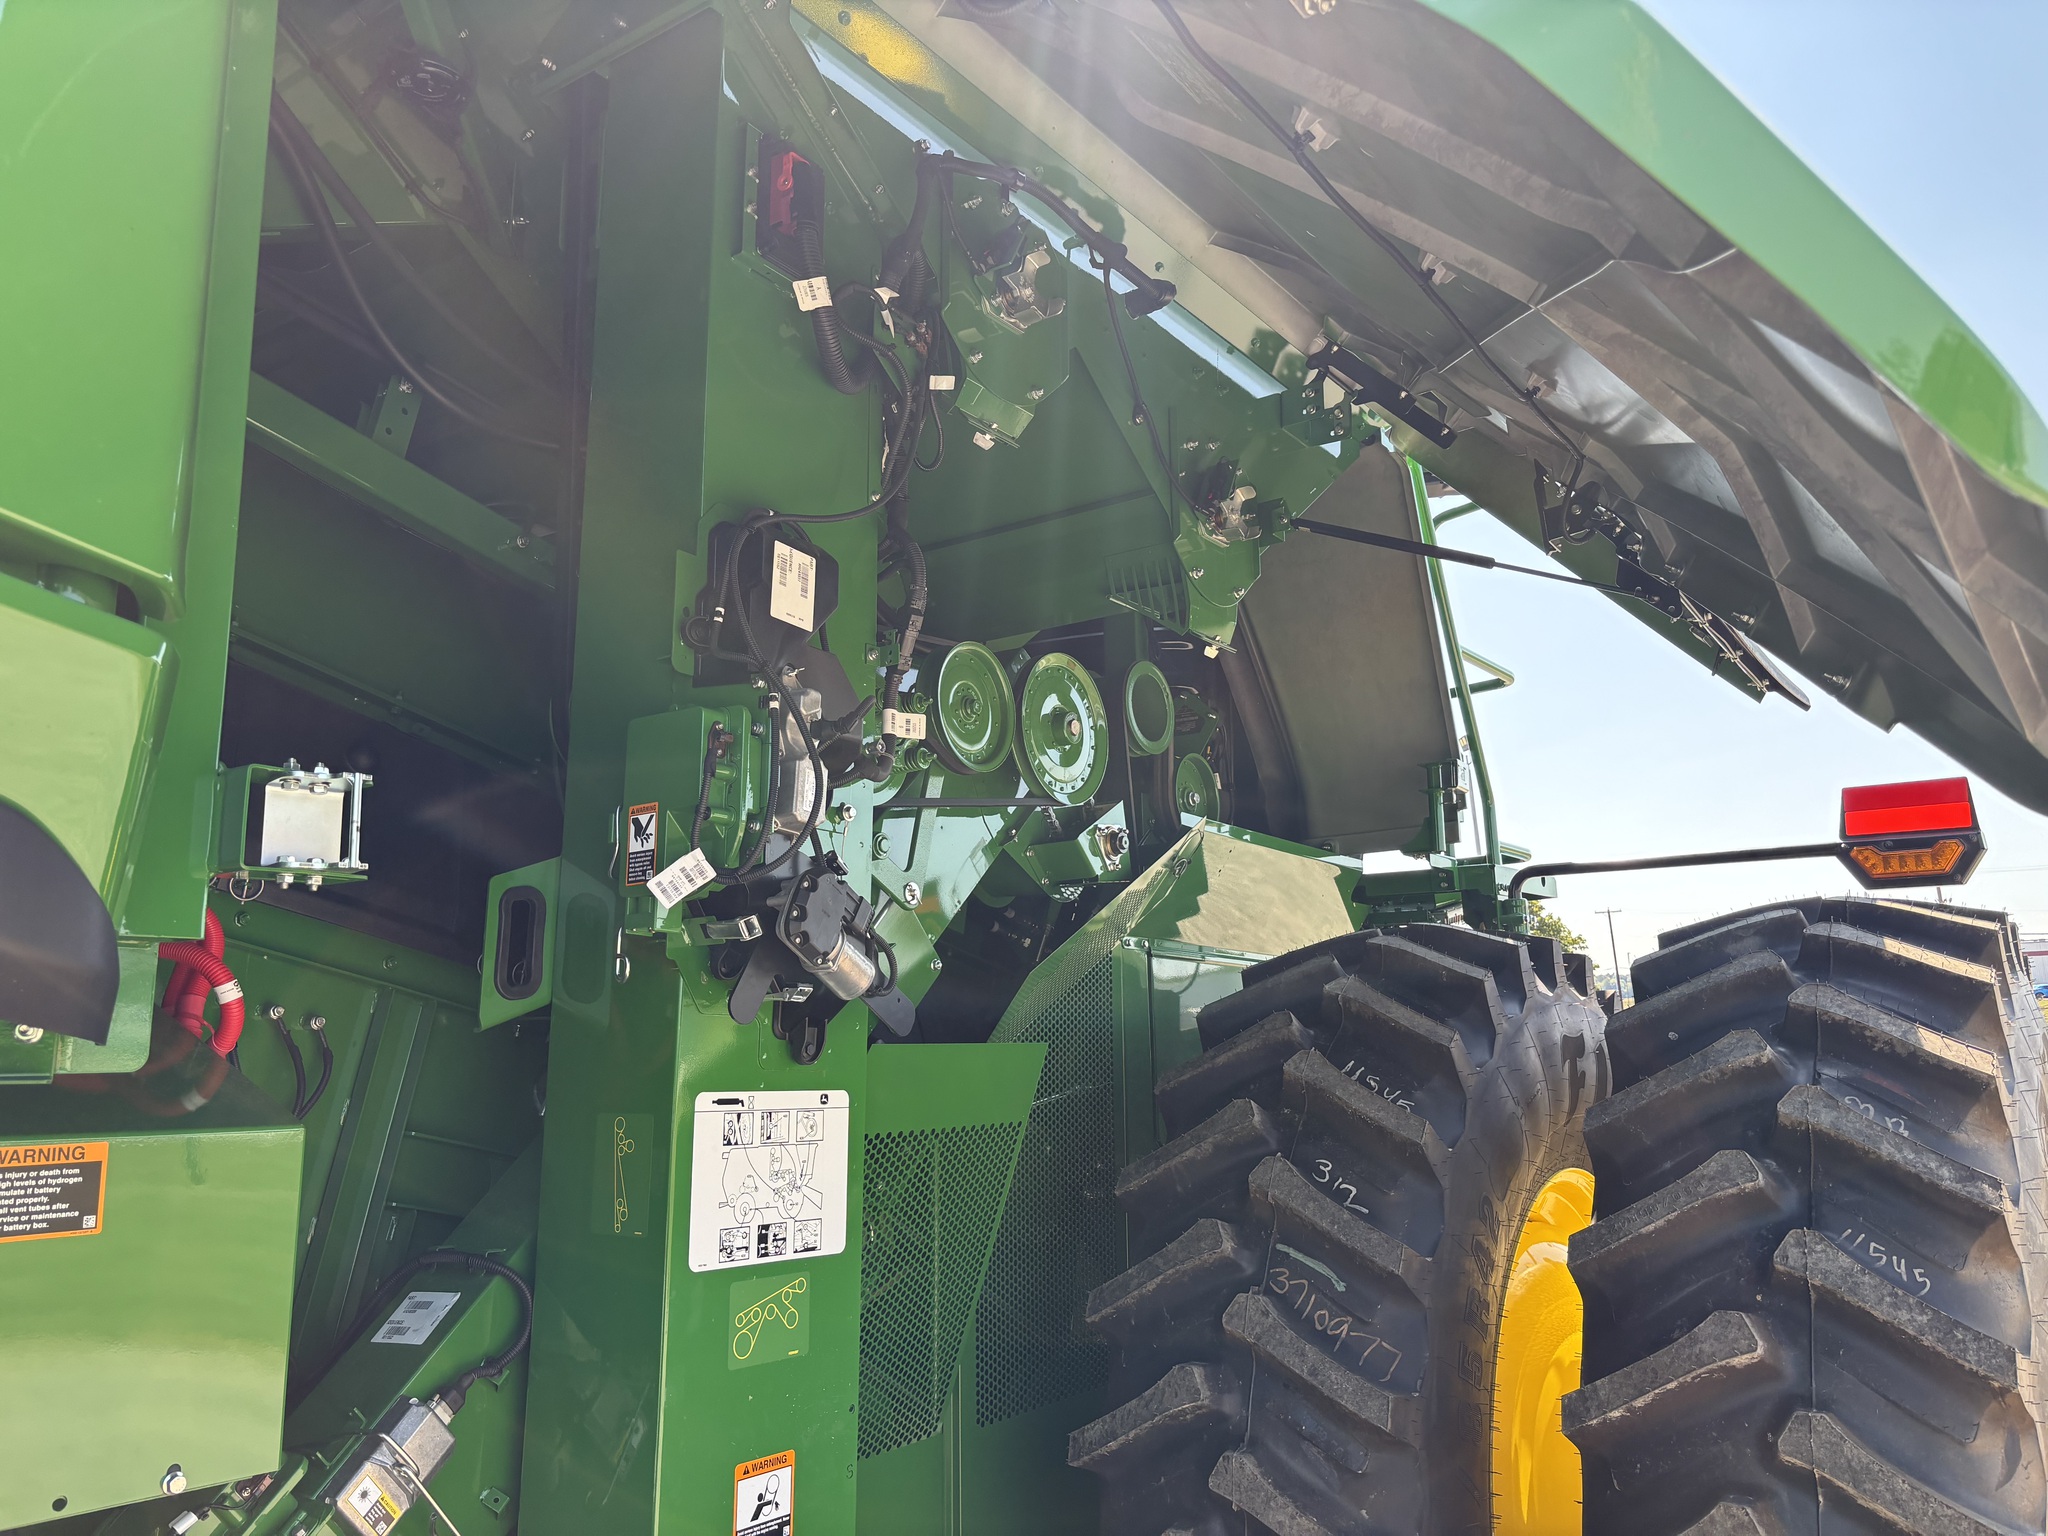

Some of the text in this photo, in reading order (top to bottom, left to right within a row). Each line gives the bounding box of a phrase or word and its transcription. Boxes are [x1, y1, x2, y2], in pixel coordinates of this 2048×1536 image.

[5, 1171, 28, 1180] injury
[13, 1179, 36, 1187] levels
[47, 1176, 83, 1185] hydrogen
[1312, 1159, 1369, 1214] 312
[27, 1187, 33, 1195] if
[34, 1186, 61, 1194] battery
[15, 1195, 50, 1206] properly.
[10, 1205, 27, 1213] vent
[28, 1204, 50, 1212] tubes
[51, 1202, 70, 1210] after
[31, 1210, 80, 1221] maintenance
[3, 1223, 31, 1231] battery
[1836, 1228, 1931, 1297] 11545
[1269, 1267, 1402, 1382] 3710977
[751, 1454, 787, 1472] WARNING
